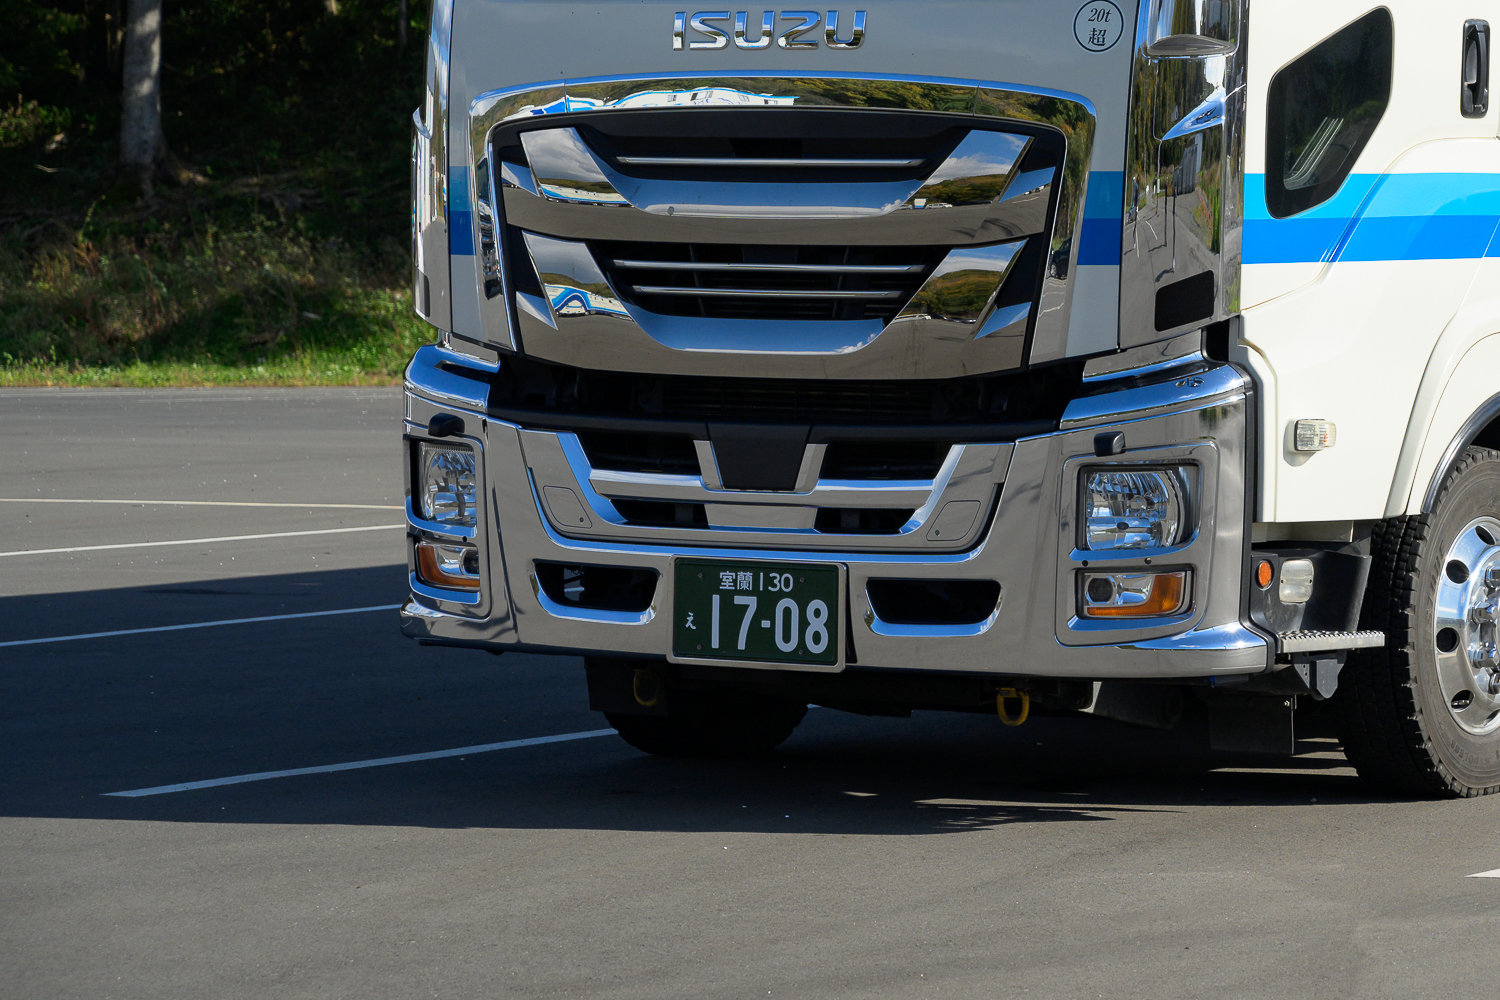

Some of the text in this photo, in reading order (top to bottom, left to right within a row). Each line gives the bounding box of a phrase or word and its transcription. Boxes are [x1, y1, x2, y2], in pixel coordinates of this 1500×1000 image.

[1088, 7, 1112, 23] 20t
[672, 10, 867, 51] ISUZU
[1087, 27, 1107, 47] 超
[685, 594, 829, 655] え 17-08
